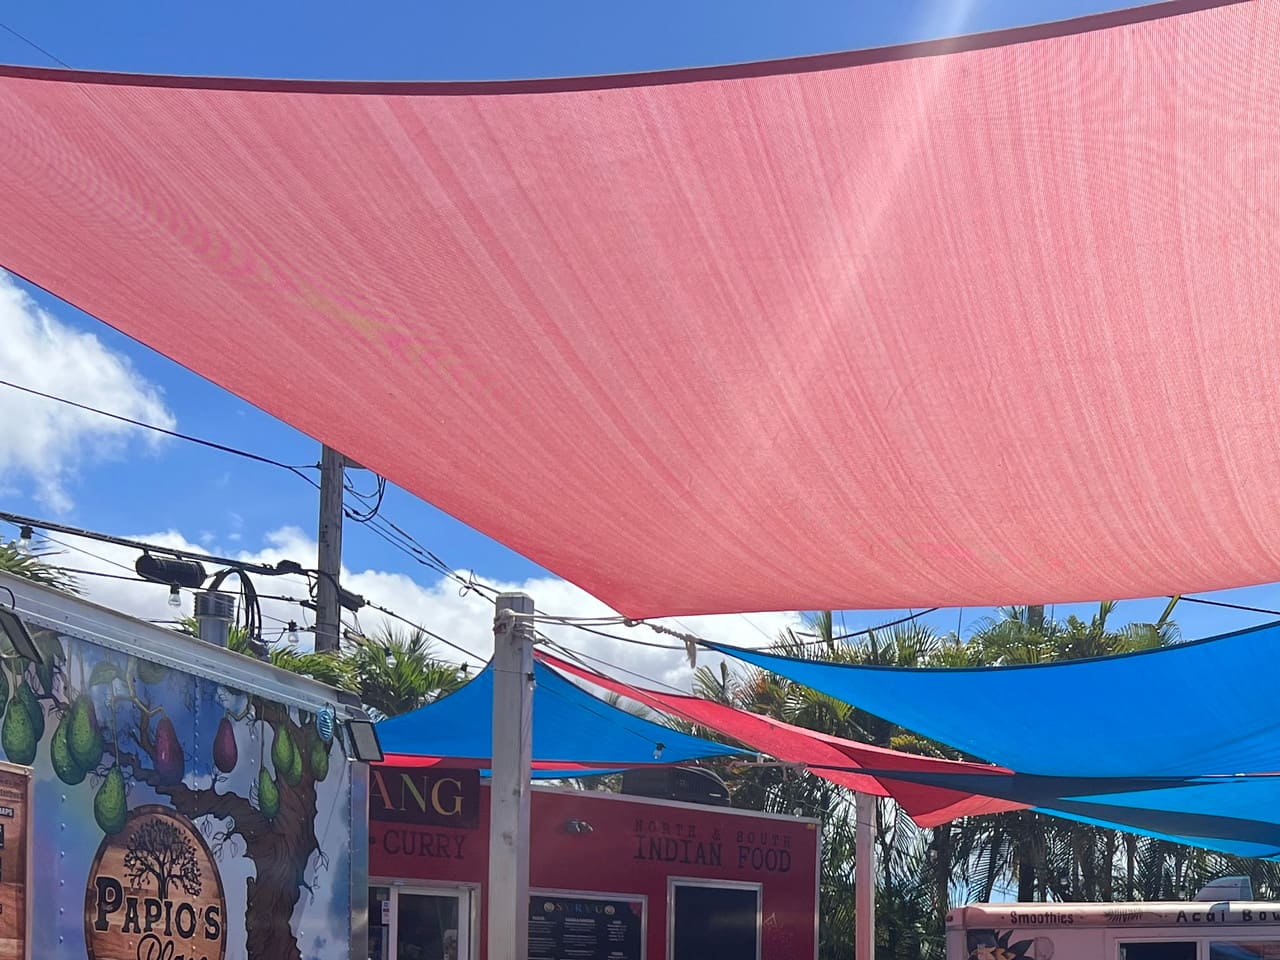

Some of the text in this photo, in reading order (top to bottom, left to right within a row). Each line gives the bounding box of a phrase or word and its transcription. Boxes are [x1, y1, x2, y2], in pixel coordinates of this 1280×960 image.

[383, 829, 465, 859] CURRY
[635, 818, 698, 840] NORTH
[736, 830, 792, 849] SOUTH
[633, 835, 792, 873] INDIAN FOOD
[94, 877, 222, 940] PAPIO'S
[1010, 911, 1074, 925] Smoothies
